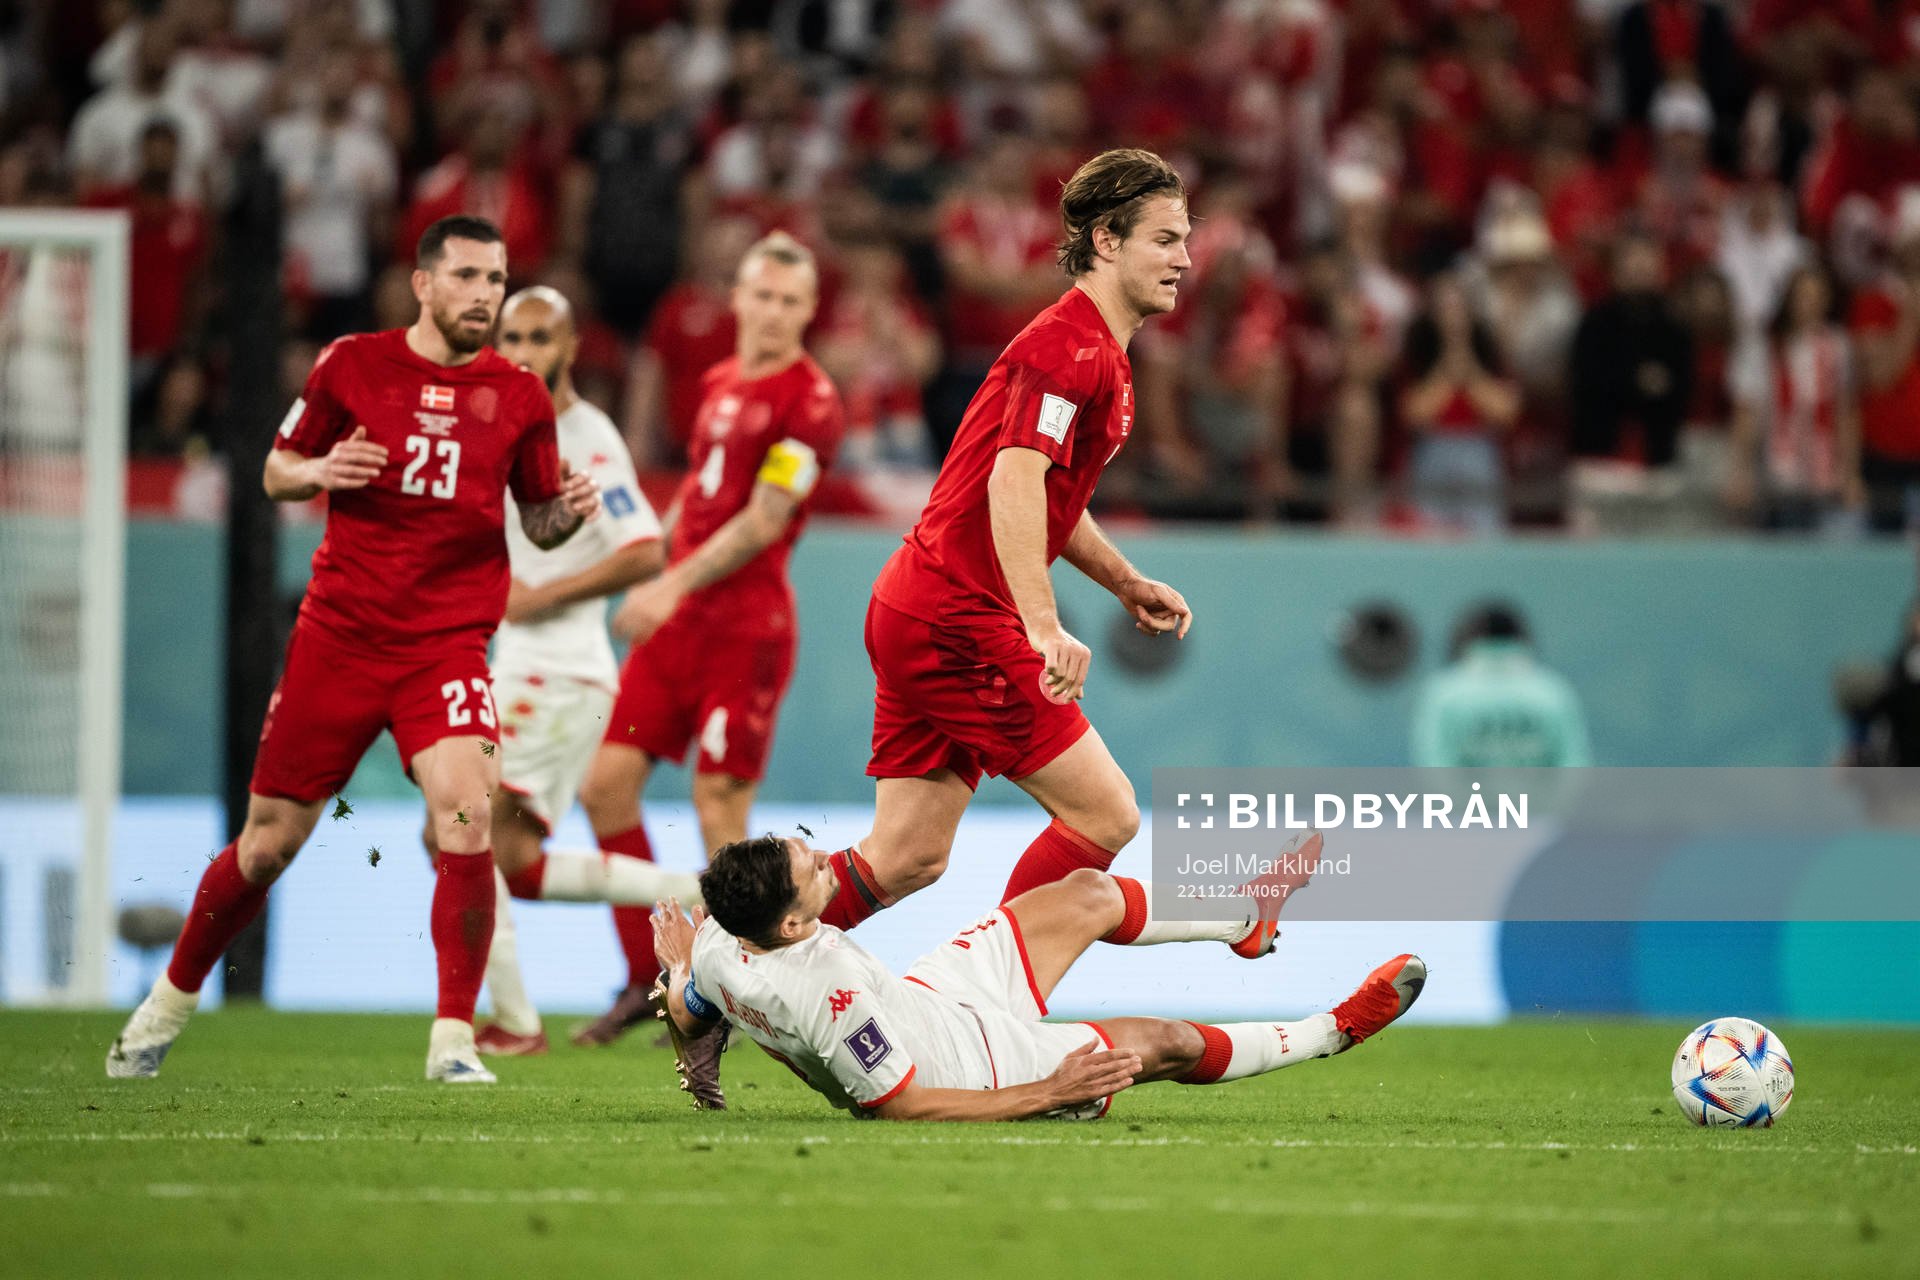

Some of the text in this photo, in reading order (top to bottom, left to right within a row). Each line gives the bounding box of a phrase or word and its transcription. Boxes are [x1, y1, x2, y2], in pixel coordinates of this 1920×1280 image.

[401, 435, 461, 499] 23
[699, 443, 725, 499] 4
[441, 677, 496, 729] 23
[701, 706, 728, 763] 4
